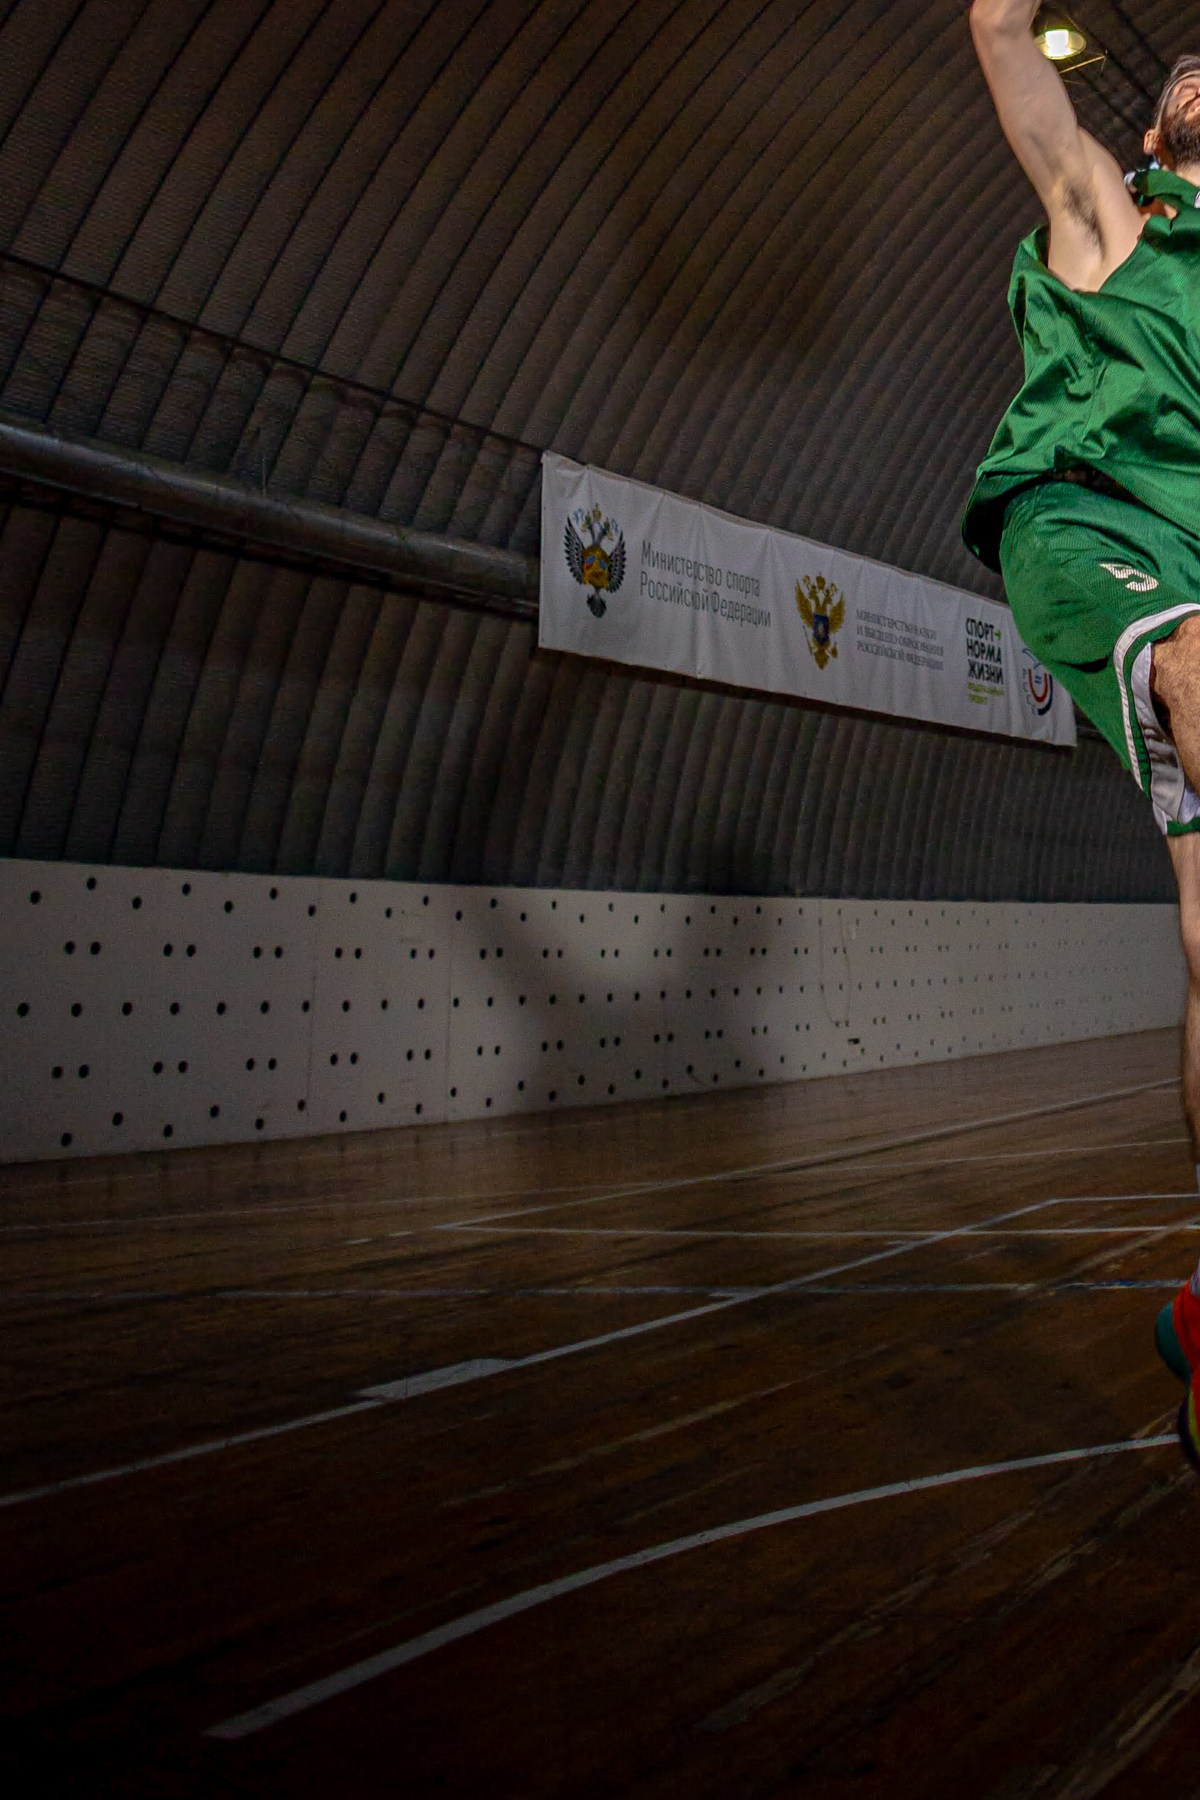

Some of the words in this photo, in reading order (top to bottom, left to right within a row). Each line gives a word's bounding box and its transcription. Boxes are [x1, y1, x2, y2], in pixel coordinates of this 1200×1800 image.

[640, 539, 722, 587] Министерство
[726, 570, 761, 598] спорта
[639, 570, 709, 612] Российской
[712, 591, 772, 628] Федерации
[966, 638, 1002, 665] НОРМА
[967, 659, 1004, 685] ЖИЗНИ
